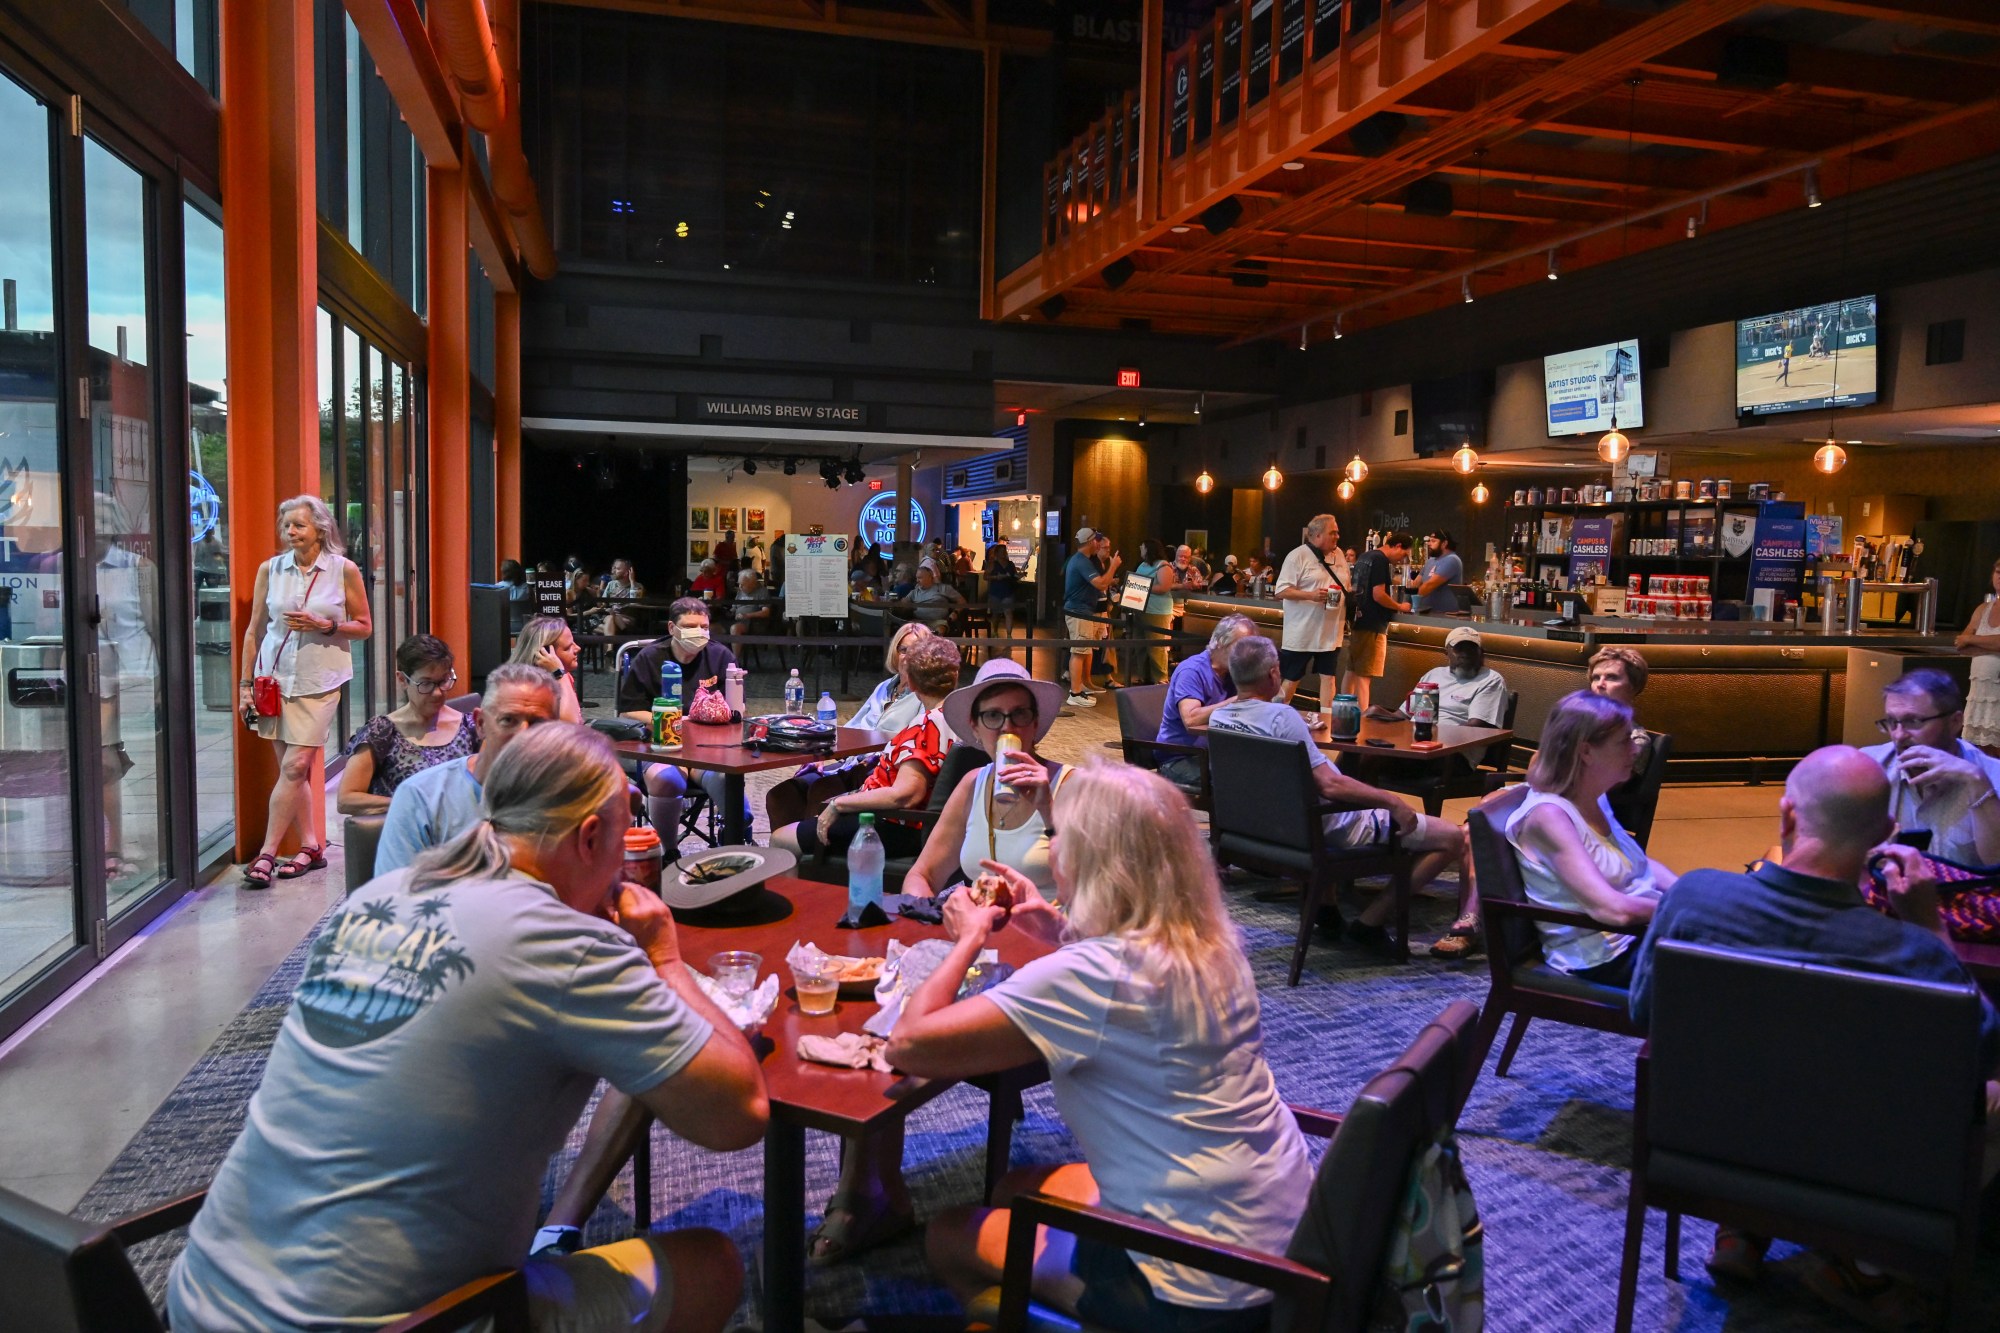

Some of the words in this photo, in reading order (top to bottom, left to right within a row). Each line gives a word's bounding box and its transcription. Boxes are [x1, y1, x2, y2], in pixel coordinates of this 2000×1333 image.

[1846, 332, 1867, 345] DICK'S
[1764, 346, 1783, 358] DICK'S
[1121, 373, 1137, 386] EXIT
[1548, 379, 1569, 389] ARTIST
[1570, 374, 1597, 386] STUDIOS
[707, 402, 772, 417] WILLIAMS
[775, 404, 813, 418] BREW
[816, 407, 860, 420] STAGE
[868, 509, 919, 524] PALEE
[1384, 512, 1410, 532] Boyle
[1573, 545, 1608, 554] CASHLESS
[1762, 539, 1793, 548] CAMPUS
[1755, 548, 1805, 558] CASHLESS
[538, 580, 563, 588] PLEASE
[540, 593, 562, 601] ENTER
[542, 605, 560, 614] HERE
[334, 911, 454, 972] VACAY
